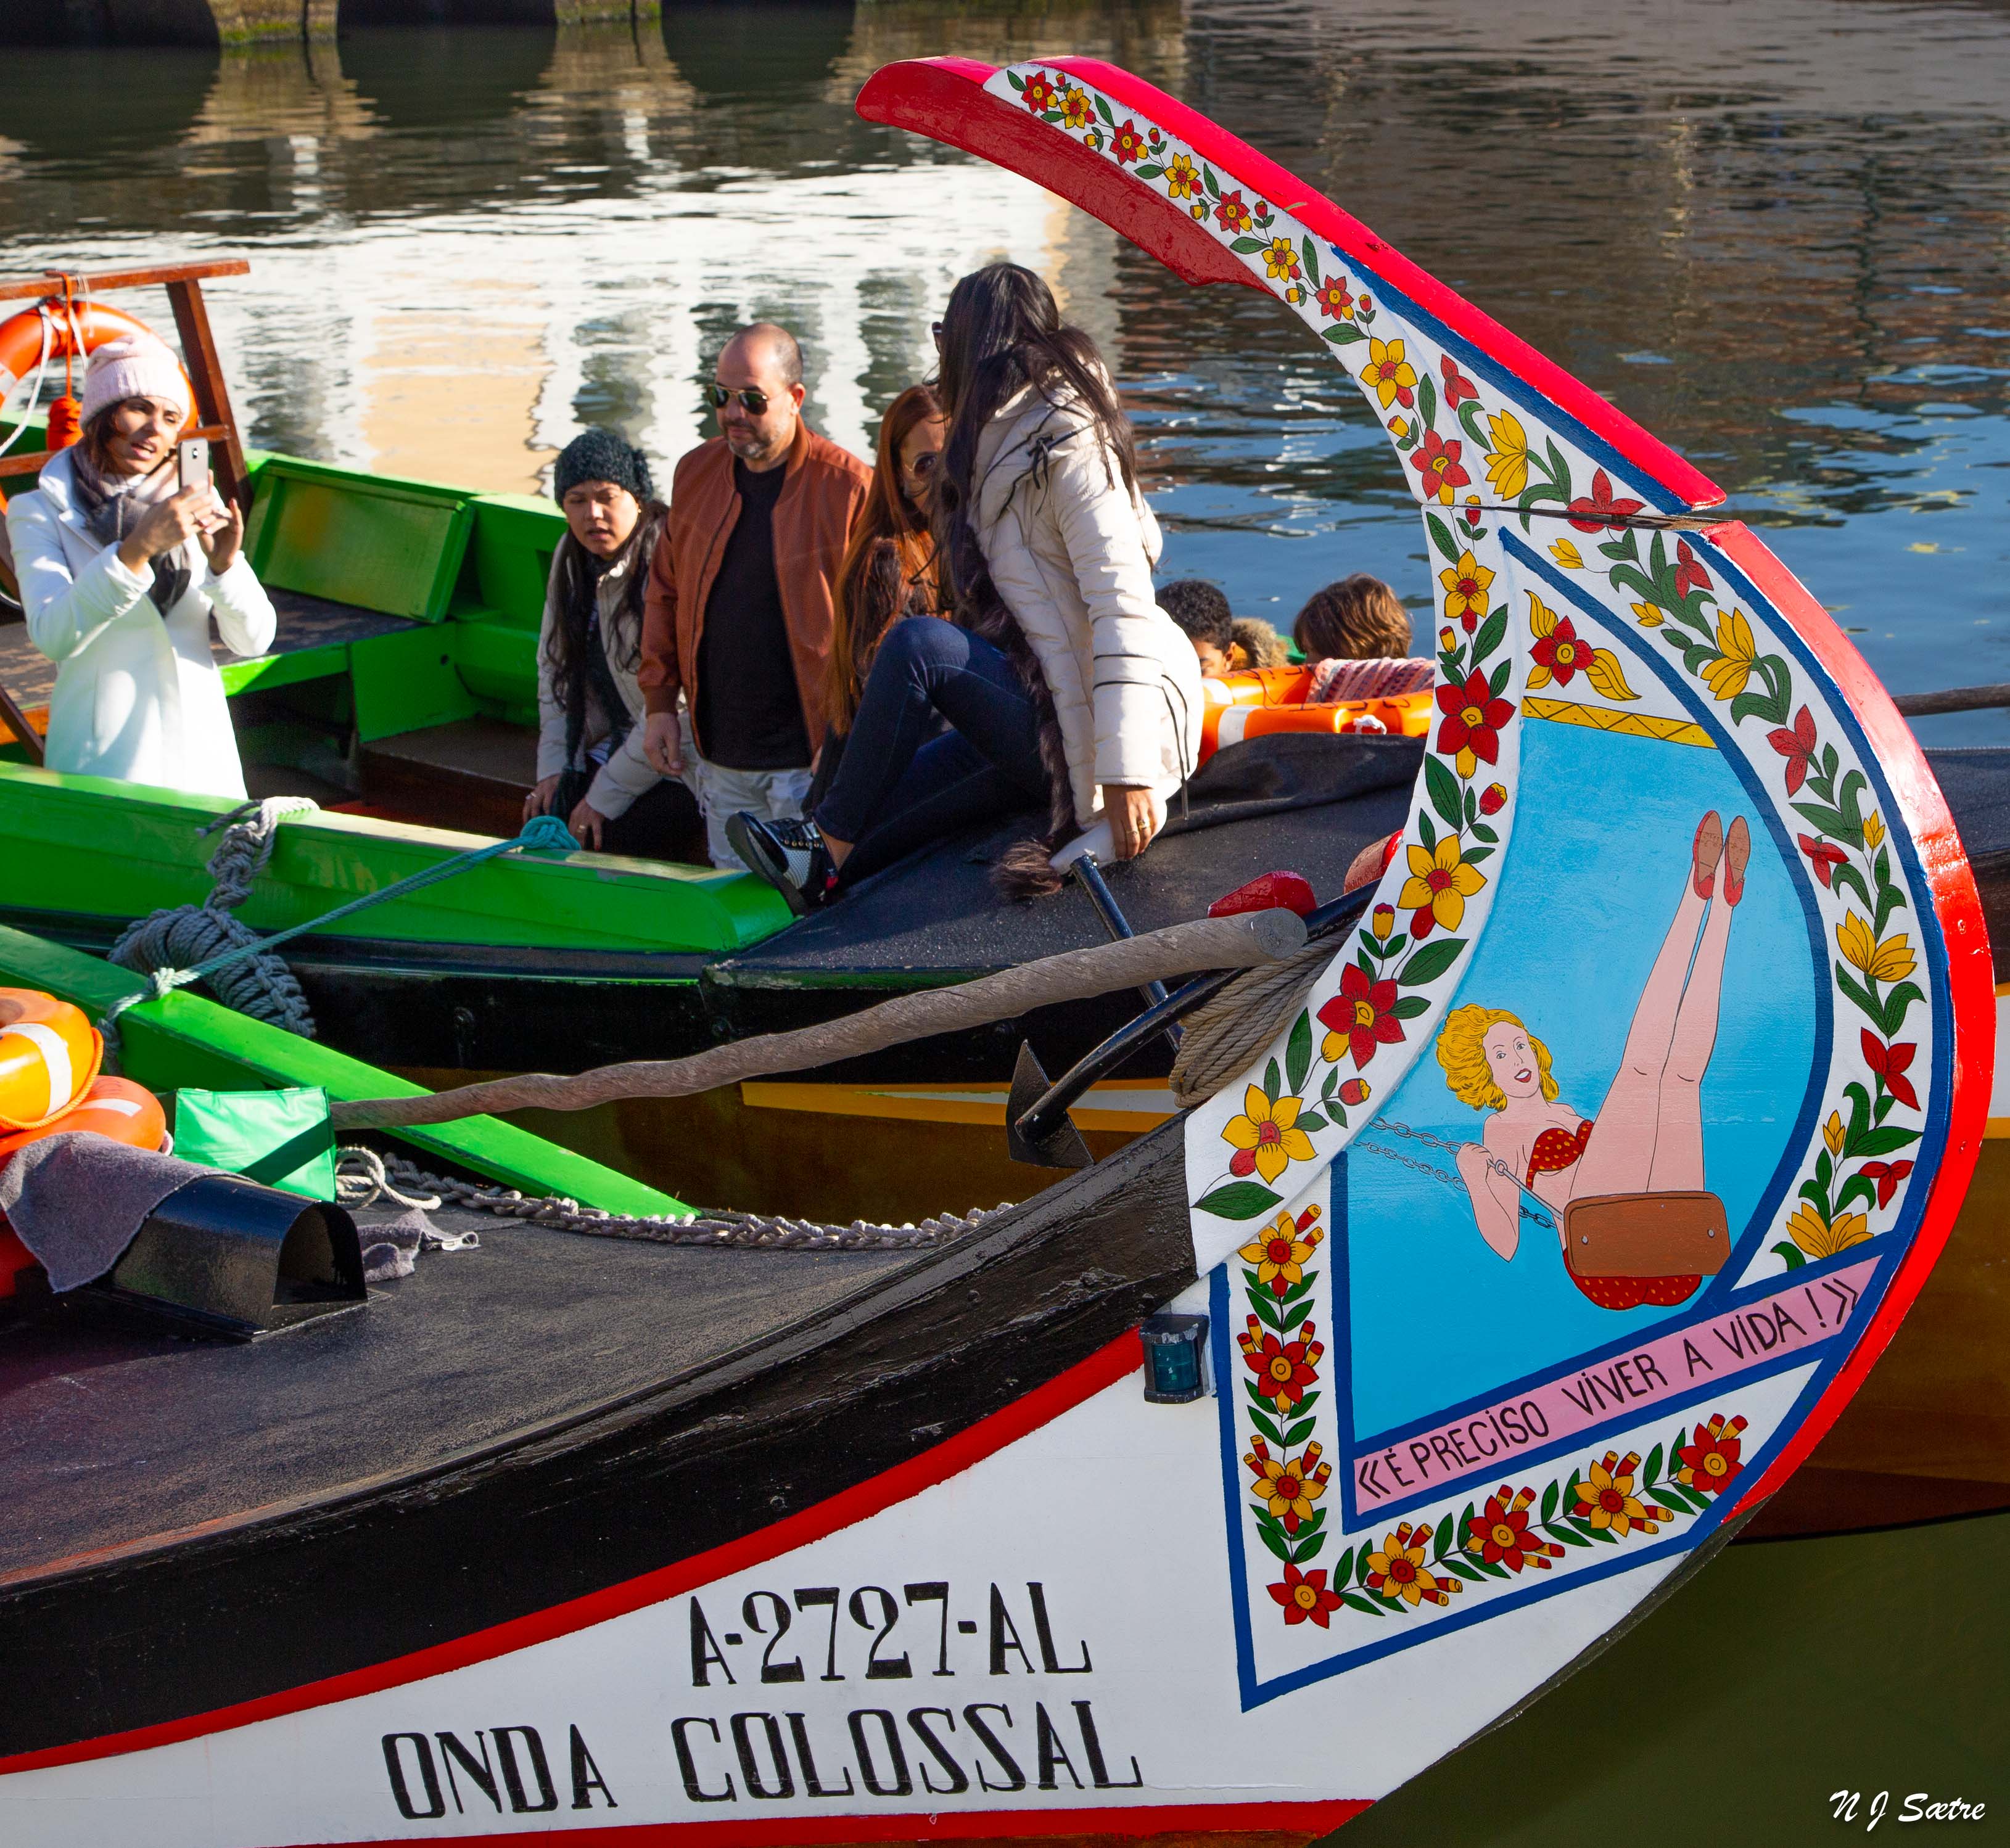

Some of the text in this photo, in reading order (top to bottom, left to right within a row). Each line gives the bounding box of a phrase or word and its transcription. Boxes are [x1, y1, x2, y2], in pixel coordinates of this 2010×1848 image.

[1683, 1338, 1713, 1378] A
[690, 1582, 1093, 1686] A-2727-AL
[382, 1701, 1144, 1820] ONDA COLOSSAL
